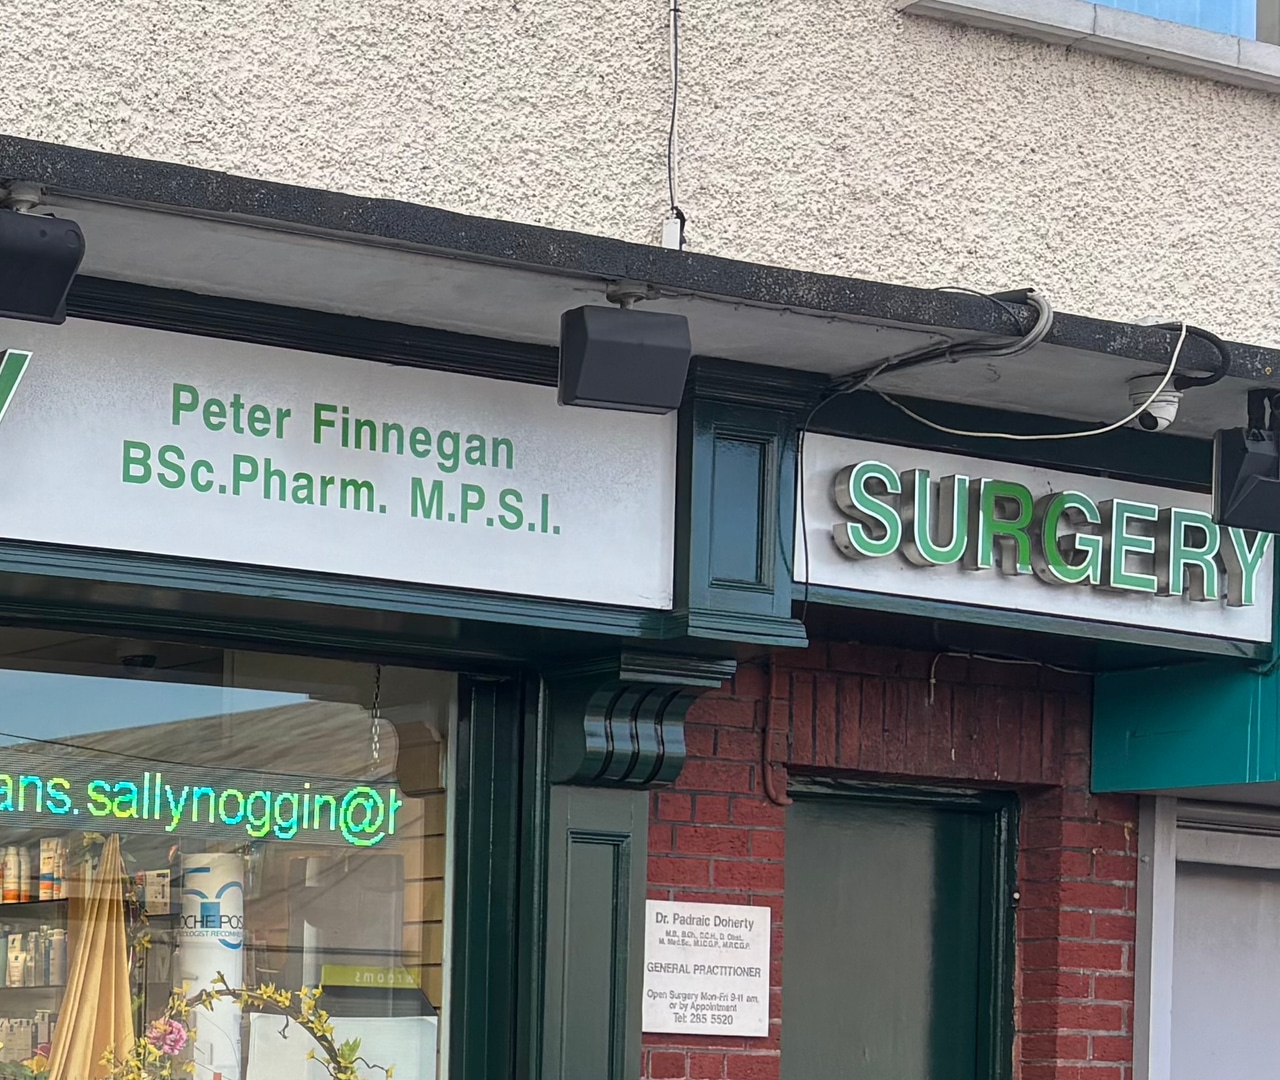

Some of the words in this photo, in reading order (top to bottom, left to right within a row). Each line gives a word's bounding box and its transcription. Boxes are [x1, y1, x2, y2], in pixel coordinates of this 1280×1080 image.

[170, 383, 292, 443] Peter
[313, 403, 517, 473] Finnegan
[120, 439, 389, 515] BSc.Pharm.
[410, 483, 562, 537] M.P.S.I.
[836, 459, 1274, 607] SURGERY
[655, 911, 670, 925] Dr.
[672, 912, 711, 927] Padraic
[713, 915, 755, 932] Doherty
[646, 961, 691, 975] GENERAL
[693, 964, 762, 978] PRACTITIONER
[646, 989, 668, 1000] Open
[669, 990, 699, 1002] Surgery
[668, 1002, 678, 1010] or
[679, 1001, 688, 1012] by
[689, 1001, 738, 1013] Appointment
[673, 1012, 687, 1024] Tel:
[689, 1012, 708, 1024] 285
[710, 1013, 734, 1026] 5520
